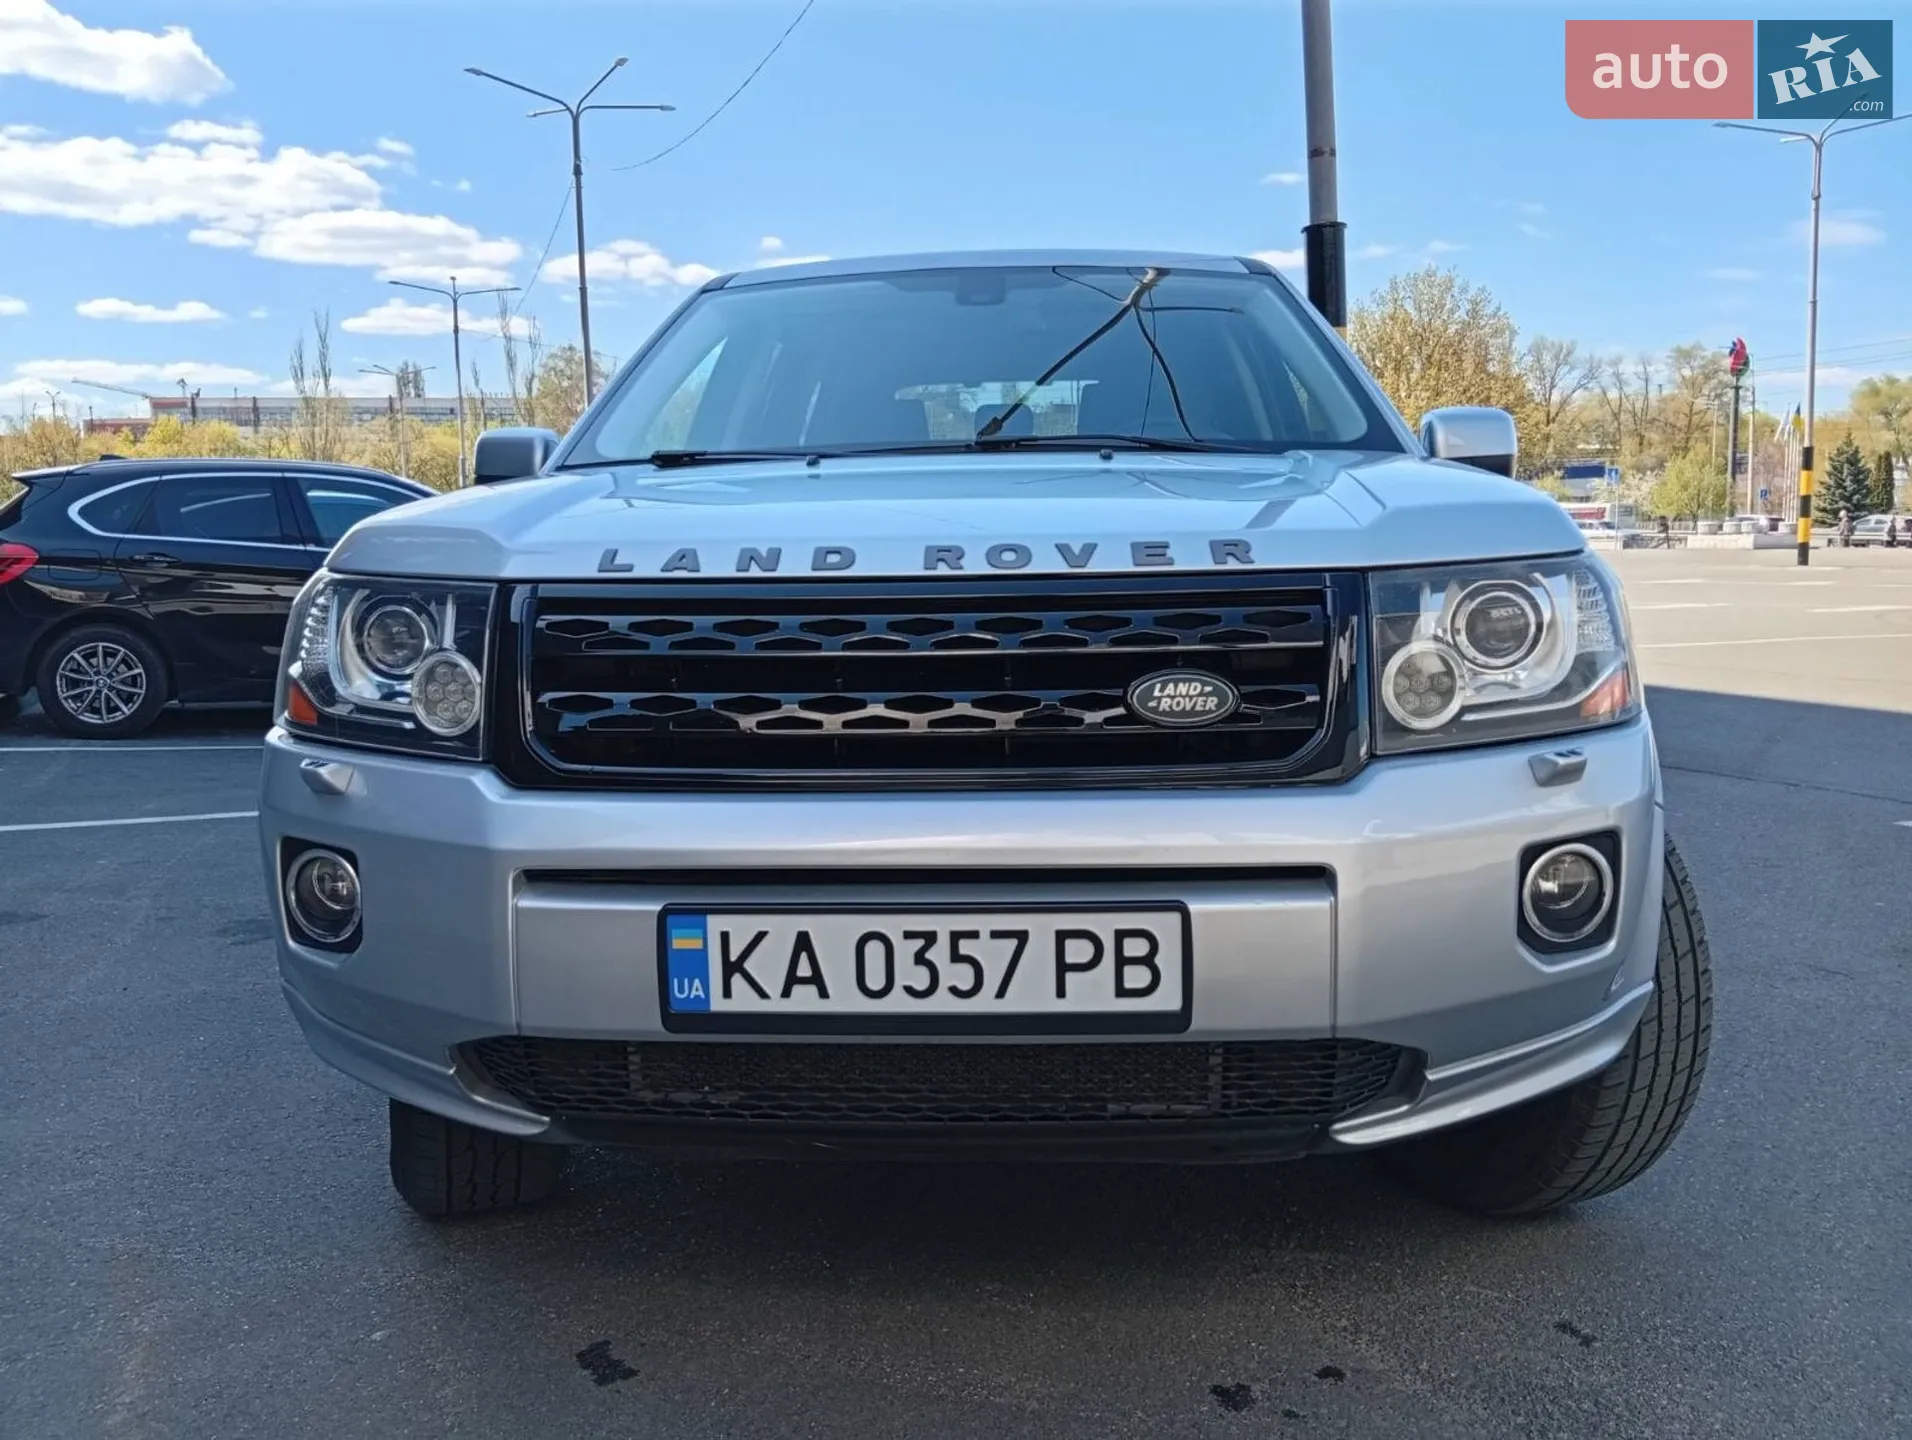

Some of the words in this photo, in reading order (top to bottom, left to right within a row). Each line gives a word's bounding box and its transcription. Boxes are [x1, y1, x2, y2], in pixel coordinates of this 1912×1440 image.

[597, 546, 856, 572] LAND
[923, 539, 1256, 570] ROVER
[719, 929, 830, 1000] KA
[854, 929, 1030, 1000] 0357
[1054, 927, 1162, 999] PB
[673, 977, 705, 999] UA
